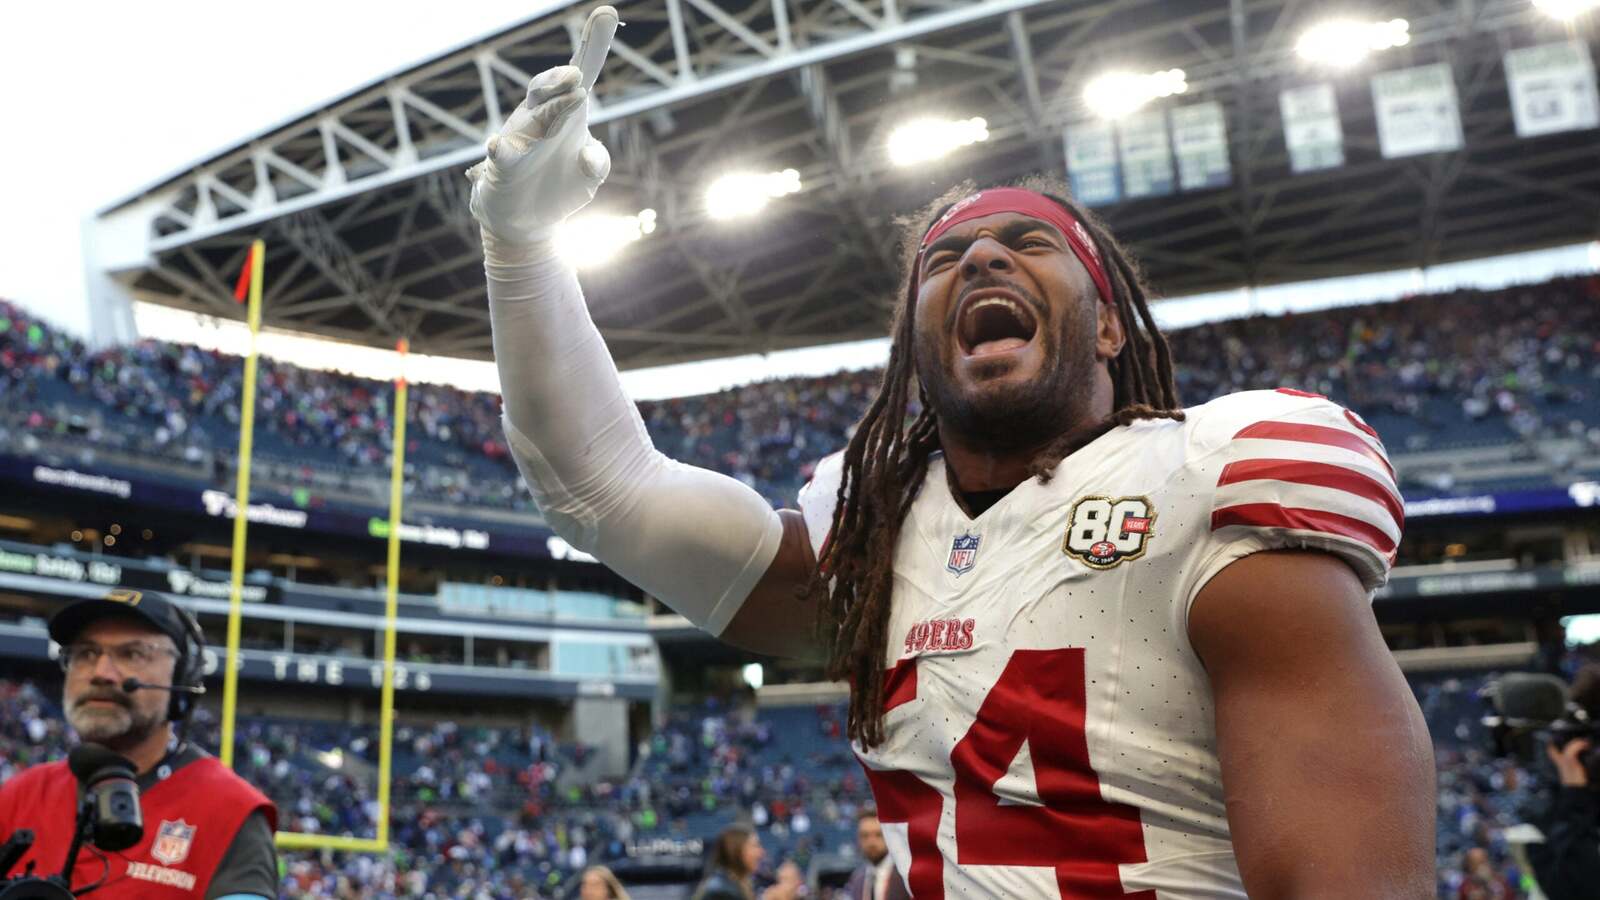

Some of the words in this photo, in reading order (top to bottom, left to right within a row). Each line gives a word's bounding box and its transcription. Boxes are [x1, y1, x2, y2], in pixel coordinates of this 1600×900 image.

[1069, 500, 1147, 551] 80
[951, 550, 973, 568] NFL
[904, 618, 976, 654] 49ERS
[273, 654, 344, 686] THE
